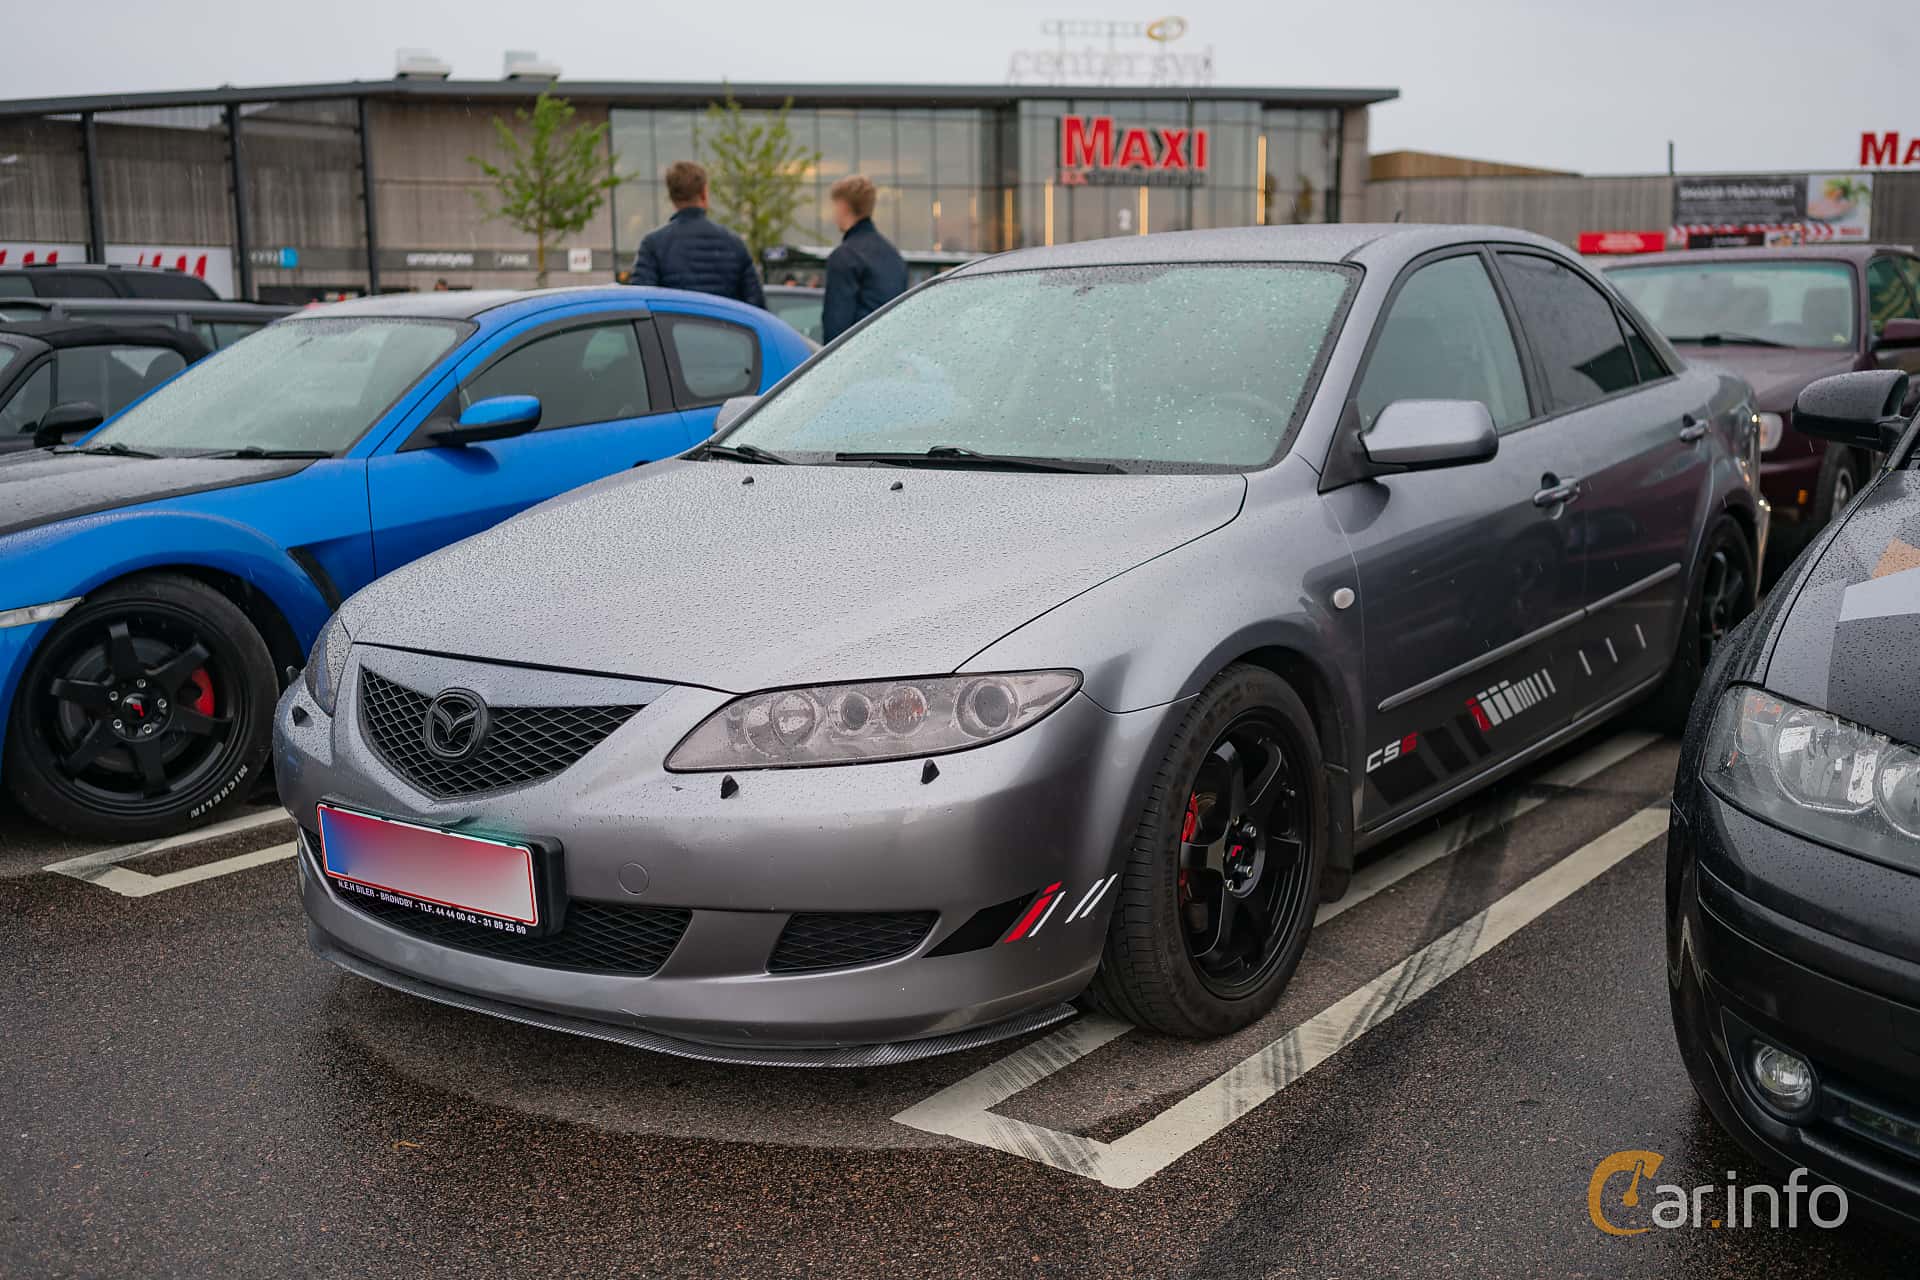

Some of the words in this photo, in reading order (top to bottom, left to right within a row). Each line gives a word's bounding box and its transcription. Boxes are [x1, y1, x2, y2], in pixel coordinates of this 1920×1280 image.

[190, 764, 248, 819] MICHELIN
[356, 885, 375, 897] BILER
[419, 903, 435, 914] TLF.
[436, 907, 445, 916] 44
[446, 910, 455, 919] 44
[456, 912, 466, 921] 00
[467, 915, 477, 924] 42
[483, 918, 492, 928] 31
[505, 922, 515, 932] 25
